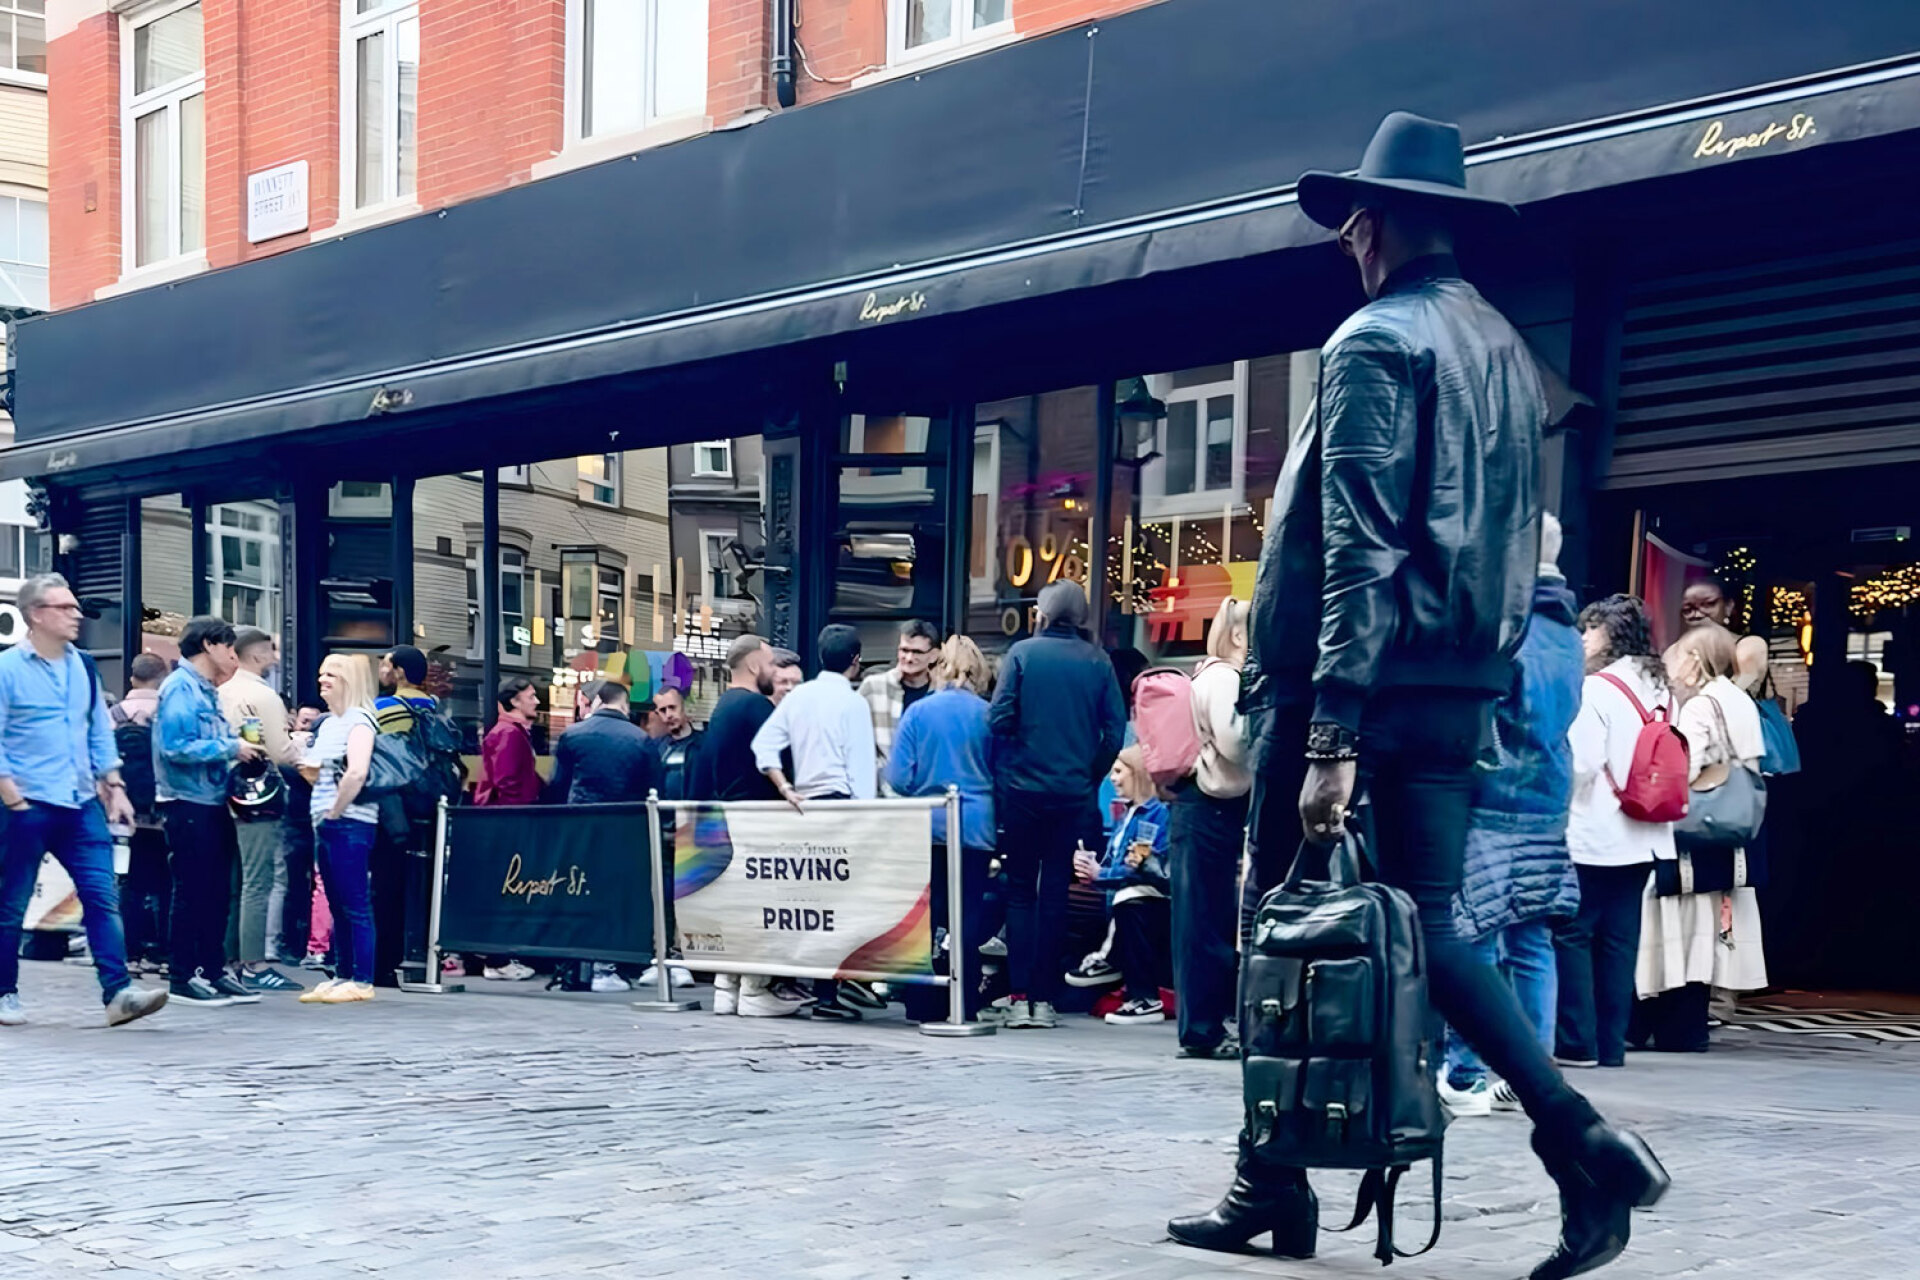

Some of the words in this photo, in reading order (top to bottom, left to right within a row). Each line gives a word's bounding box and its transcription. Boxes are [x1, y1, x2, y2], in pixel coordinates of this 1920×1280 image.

[1693, 120, 1787, 158] Rupert
[1786, 113, 1817, 141] St.
[566, 864, 590, 896] St.
[745, 857, 850, 882] SERVING
[763, 907, 835, 931] PRIDE
